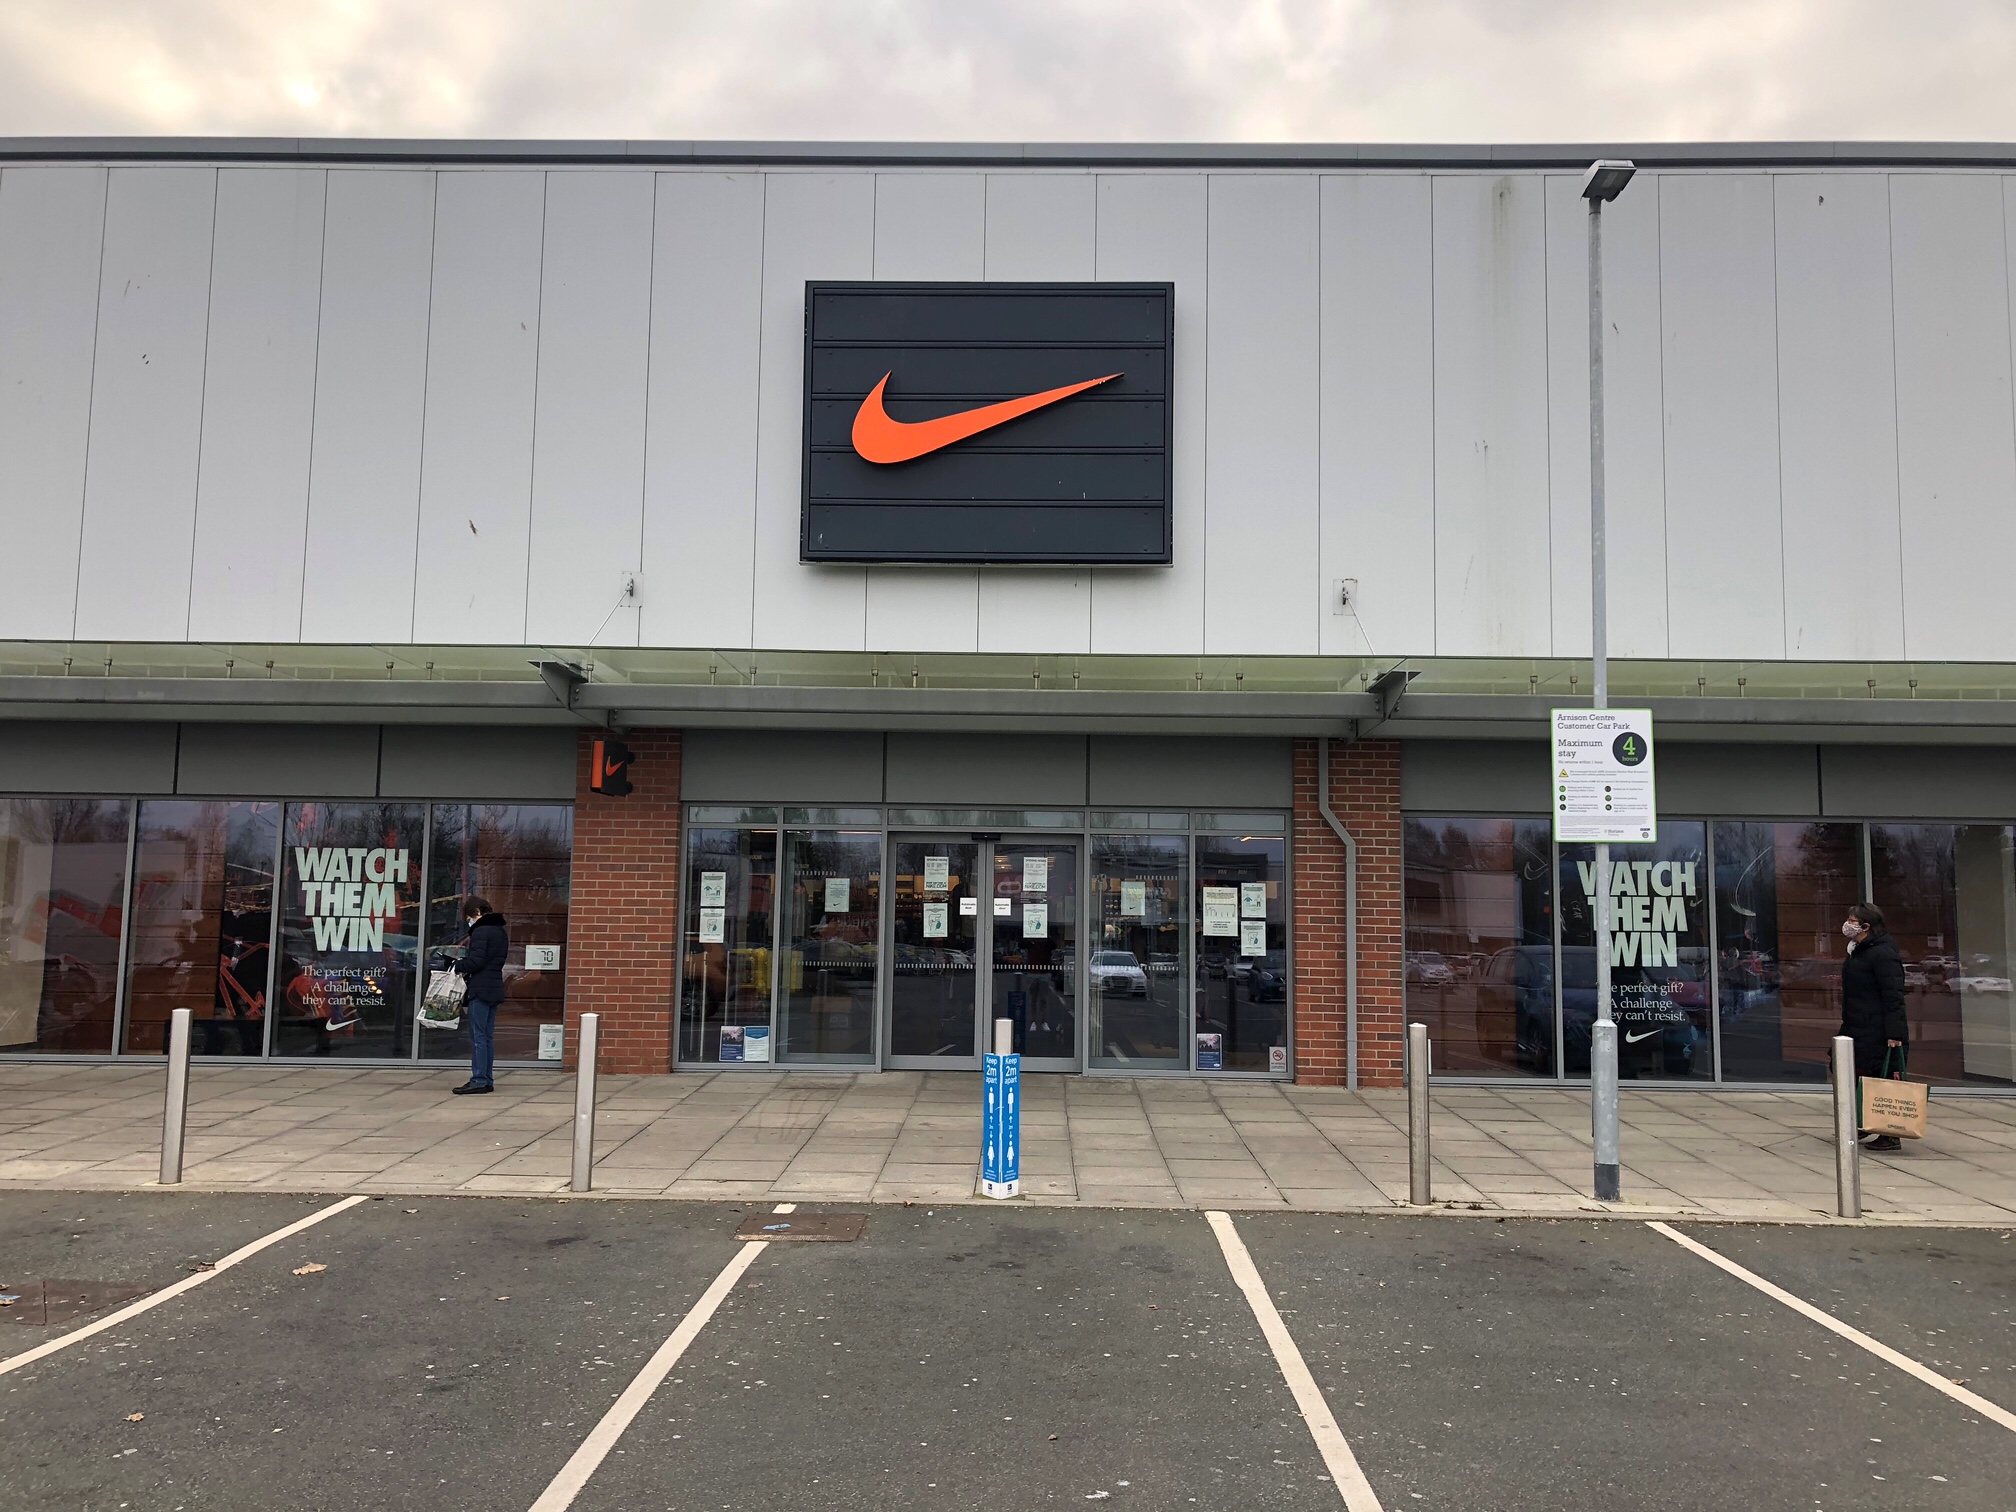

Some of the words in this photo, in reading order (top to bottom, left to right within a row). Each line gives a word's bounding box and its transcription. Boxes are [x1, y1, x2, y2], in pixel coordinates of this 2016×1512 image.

[1558, 739, 1603, 747] Maximum
[1622, 736, 1636, 755] 4
[1558, 750, 1577, 759] stay
[295, 847, 409, 883] WATCH
[1576, 861, 1696, 896] WATCH
[301, 882, 396, 918] THEM
[312, 917, 384, 952] WIN
[1609, 932, 1678, 967] WIN
[301, 965, 323, 977] The
[324, 966, 361, 980] perfect
[363, 967, 387, 981] gift?
[312, 982, 322, 992] A
[323, 981, 376, 996] challenge
[1620, 982, 1658, 996] perfect
[1660, 982, 1684, 997] gift?
[302, 994, 326, 1009] they
[327, 995, 354, 1006] can't
[355, 996, 386, 1006] resist.
[1610, 998, 1618, 1009] A
[1620, 998, 1673, 1012] challenge
[1625, 1010, 1653, 1021] can't
[1654, 1011, 1686, 1022] resist.
[985, 1056, 998, 1065] Keep
[1005, 1057, 1018, 1065] Keep
[986, 1064, 997, 1077] 2m
[1005, 1065, 1017, 1077] 2m
[985, 1076, 998, 1085] apart
[1004, 1076, 1018, 1086] apart
